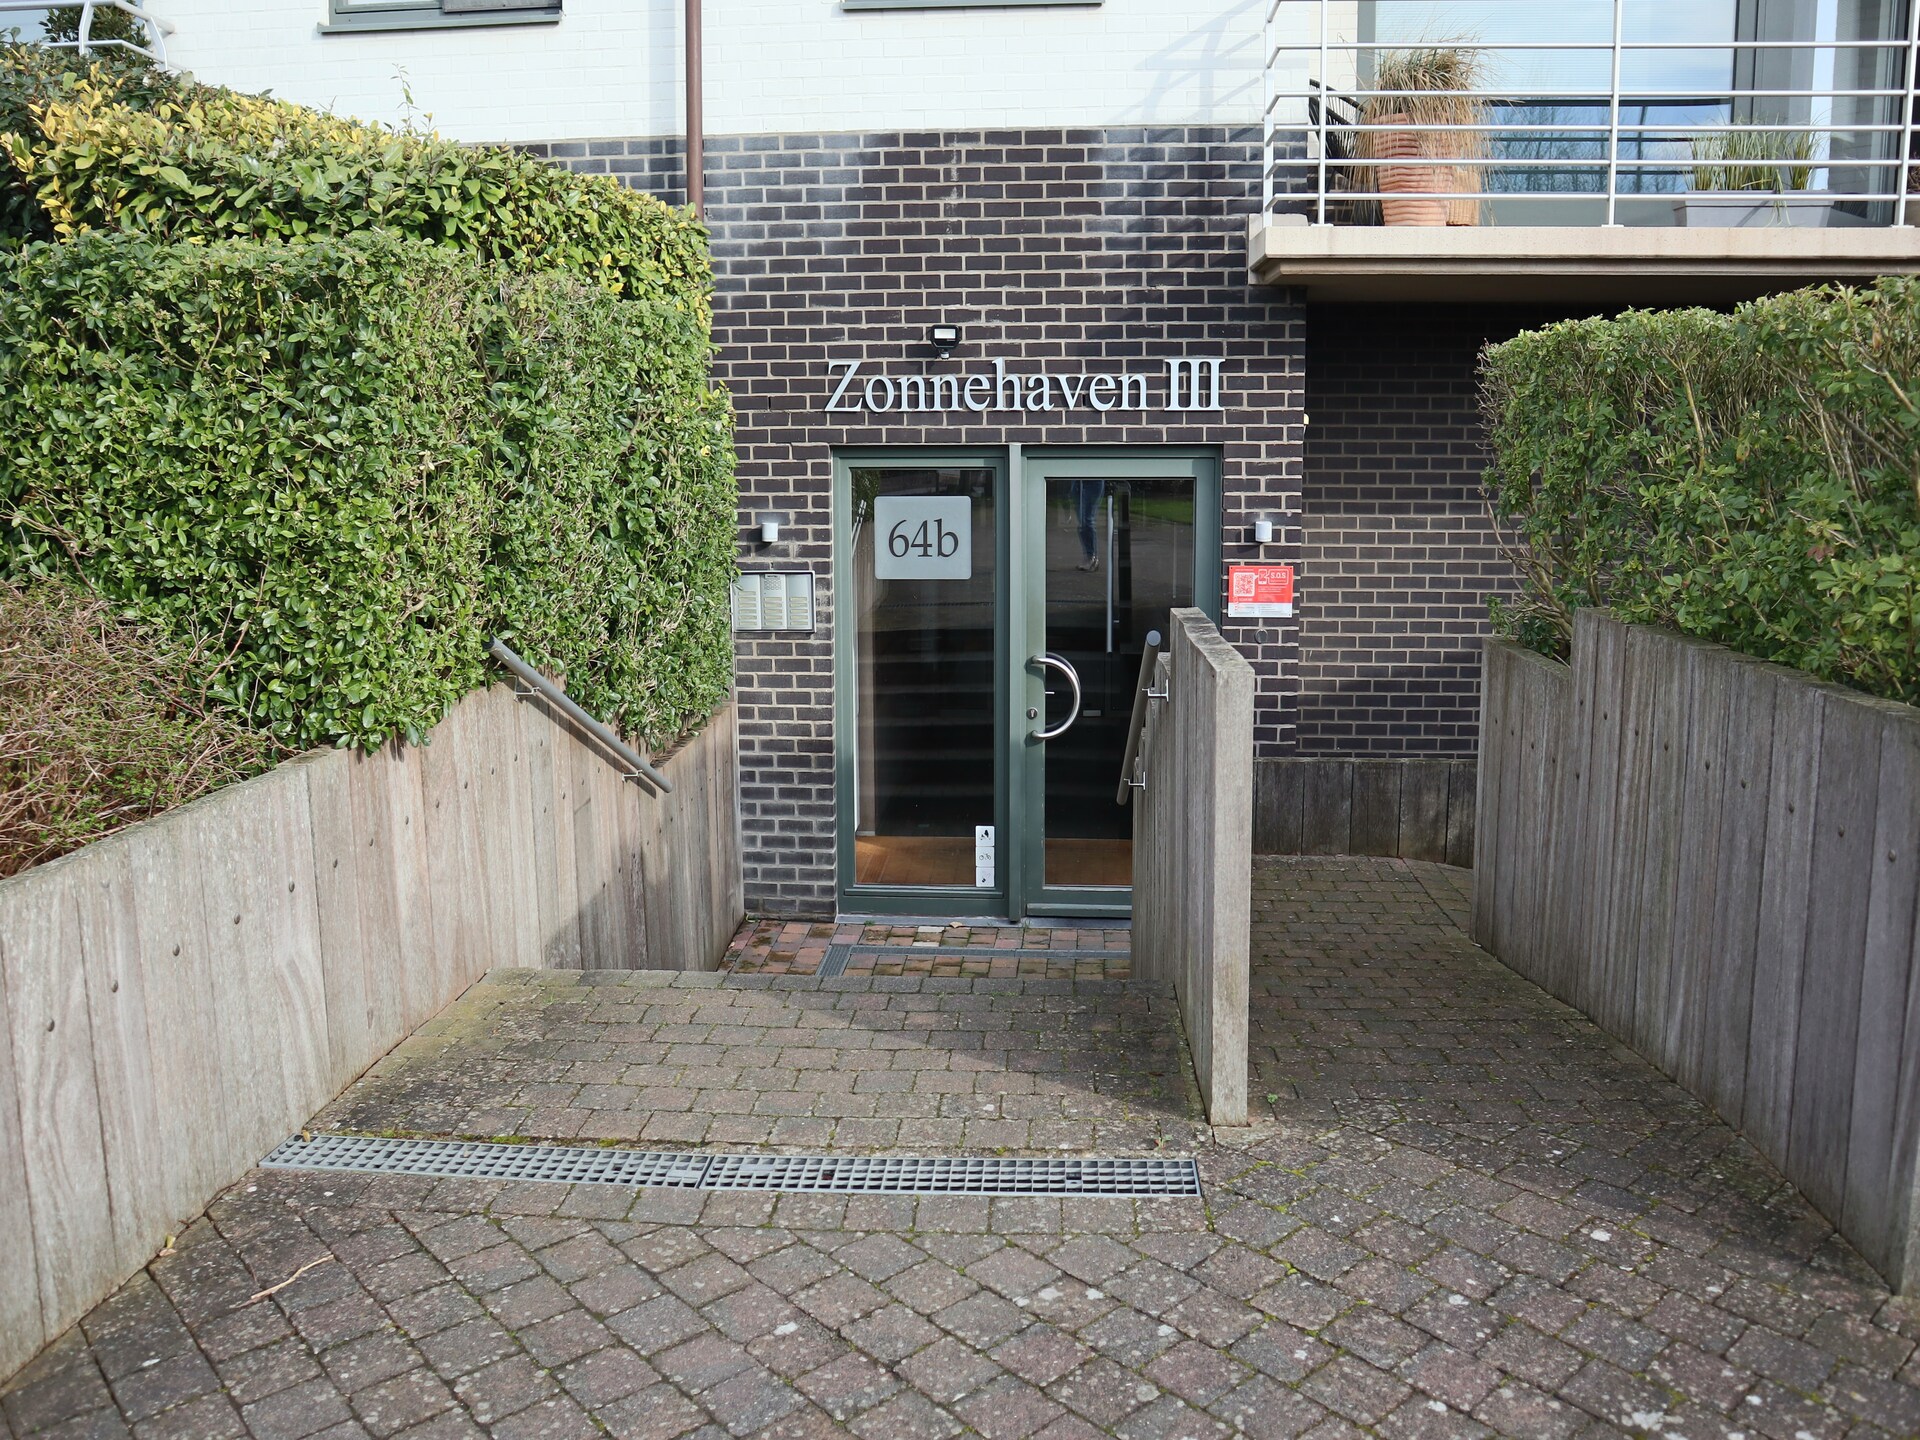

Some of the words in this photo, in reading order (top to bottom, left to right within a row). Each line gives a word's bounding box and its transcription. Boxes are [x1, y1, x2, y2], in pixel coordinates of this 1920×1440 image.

[824, 357, 1151, 413] Zonnehaven
[1164, 358, 1226, 411] III
[888, 518, 959, 558] 64b
